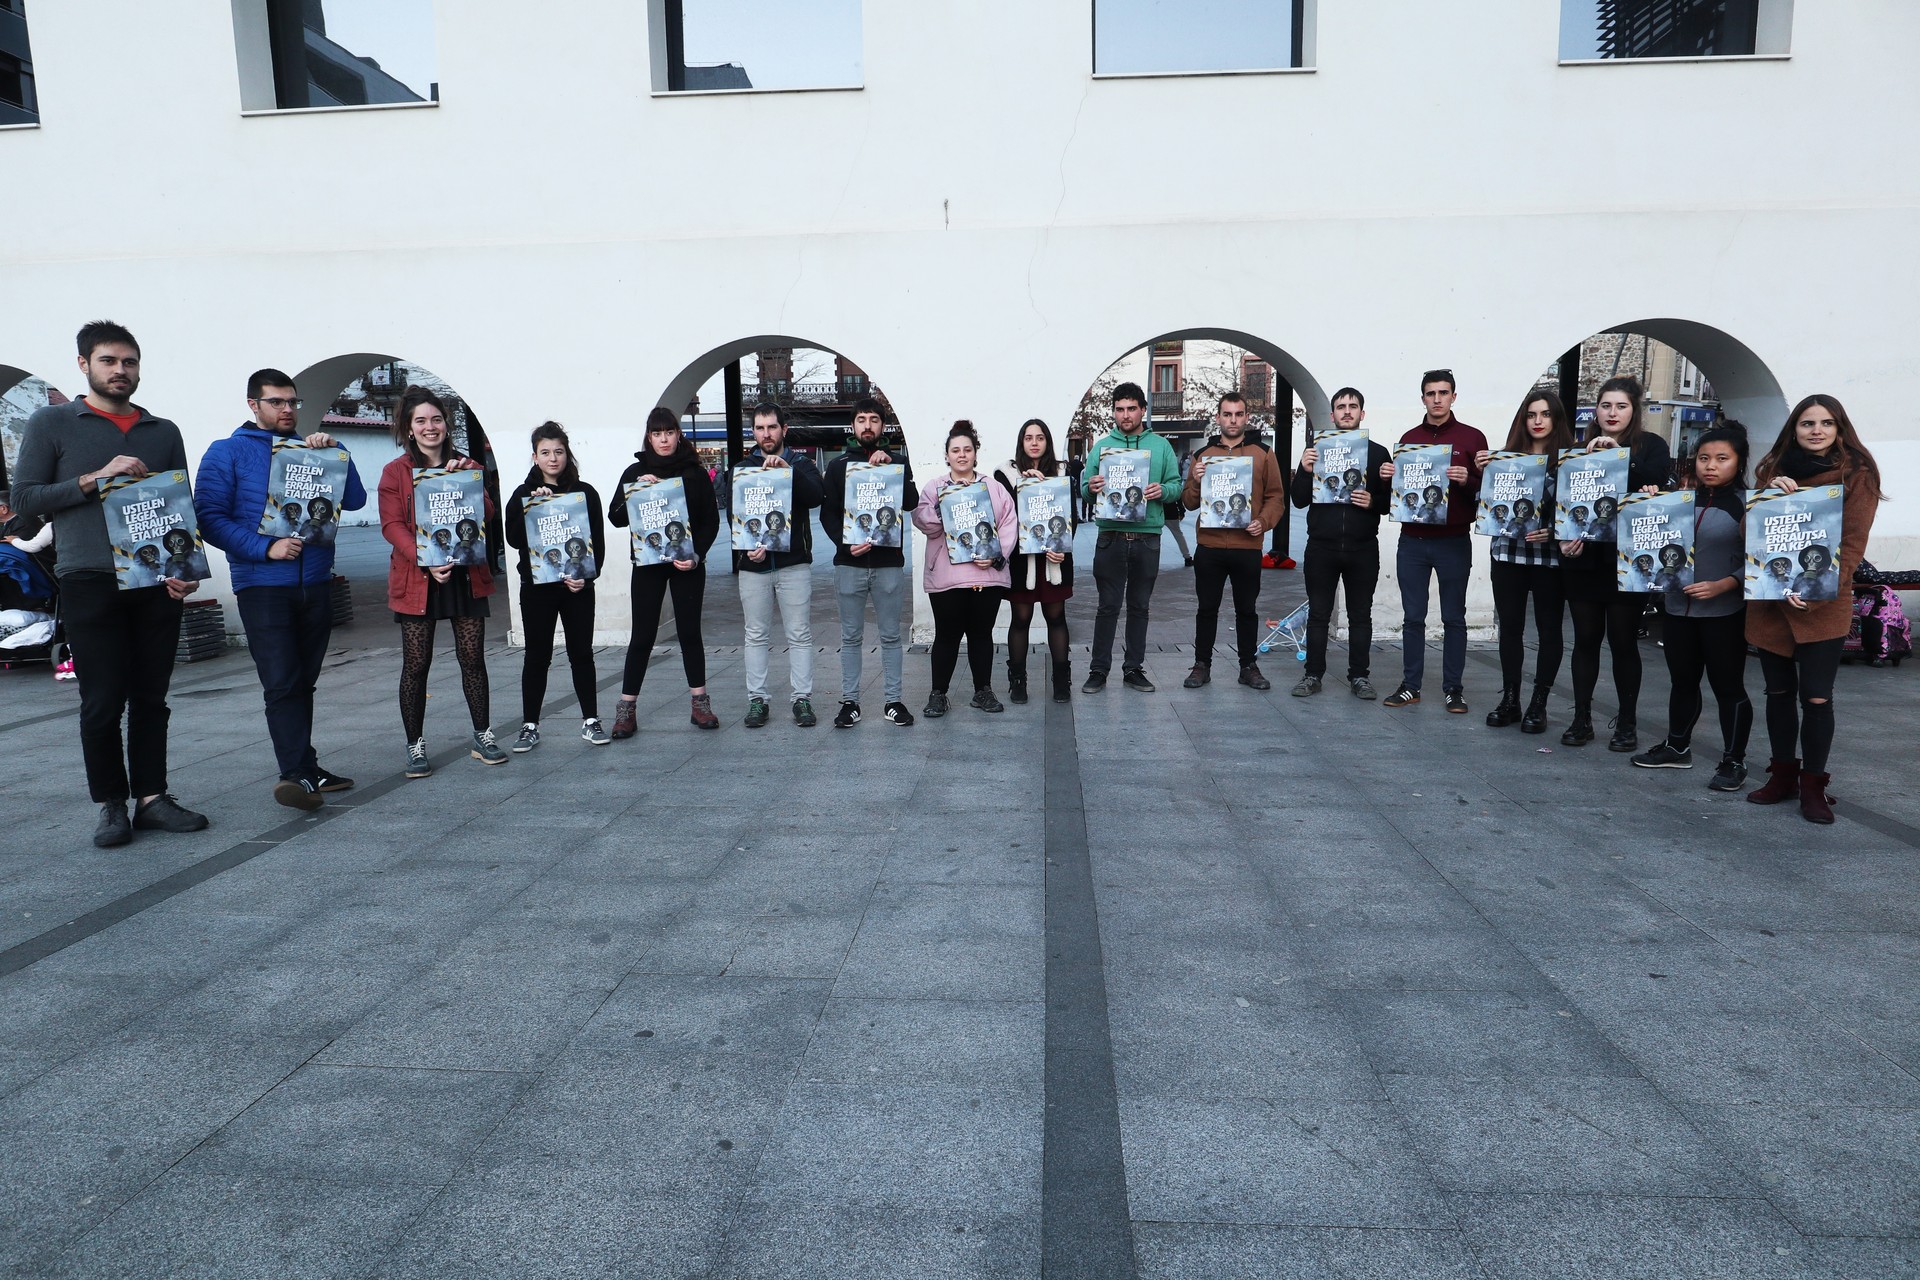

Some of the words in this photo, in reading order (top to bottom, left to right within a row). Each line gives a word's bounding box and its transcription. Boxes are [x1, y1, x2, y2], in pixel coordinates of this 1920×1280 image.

[1325, 458, 1359, 467] ERRAUTSA
[286, 465, 324, 476] USTELEN
[1569, 469, 1605, 479] USTELEN
[285, 472, 312, 482] LEGEA
[285, 482, 332, 493] ERRAUTSA
[1570, 479, 1595, 487] LEGEA
[284, 489, 300, 498] ETA
[1570, 484, 1616, 494] ERRAUTSA
[428, 491, 463, 500] USTELEN
[1028, 494, 1054, 503] USTELEN
[1570, 494, 1585, 502] ETA
[122, 498, 165, 515] USTELEN
[430, 501, 455, 509] LEGEA
[638, 498, 668, 510] USTELEN
[951, 500, 977, 511] USTELEN
[431, 506, 475, 517] ERRAUTSA
[640, 507, 662, 517] LEGEA
[953, 508, 972, 518] LEGEA
[1030, 506, 1063, 515] ERRAUTSA
[125, 511, 157, 525] LEGEA
[432, 516, 447, 525] ETA
[537, 513, 568, 525] USTELEN
[642, 510, 680, 523] ERRAUTSA
[954, 510, 988, 524] ERRAUTSA
[1631, 514, 1668, 526] USTELEN
[1764, 512, 1812, 525] USTELEN
[128, 514, 183, 533] ERRAUTSA
[539, 522, 562, 532] LEGEA
[644, 521, 657, 530] ETA
[956, 522, 968, 530] ETA
[541, 526, 581, 539] ERRAUTSA
[1632, 525, 1659, 534] LEGEA
[1765, 524, 1799, 535] LEGEA
[132, 530, 151, 542] ETA
[1633, 530, 1681, 542] ERRAUTSA
[1766, 529, 1827, 544] ERRAUTSA
[543, 537, 556, 546] ETA
[1634, 541, 1650, 550] ETA
[1767, 543, 1787, 553] ETA
